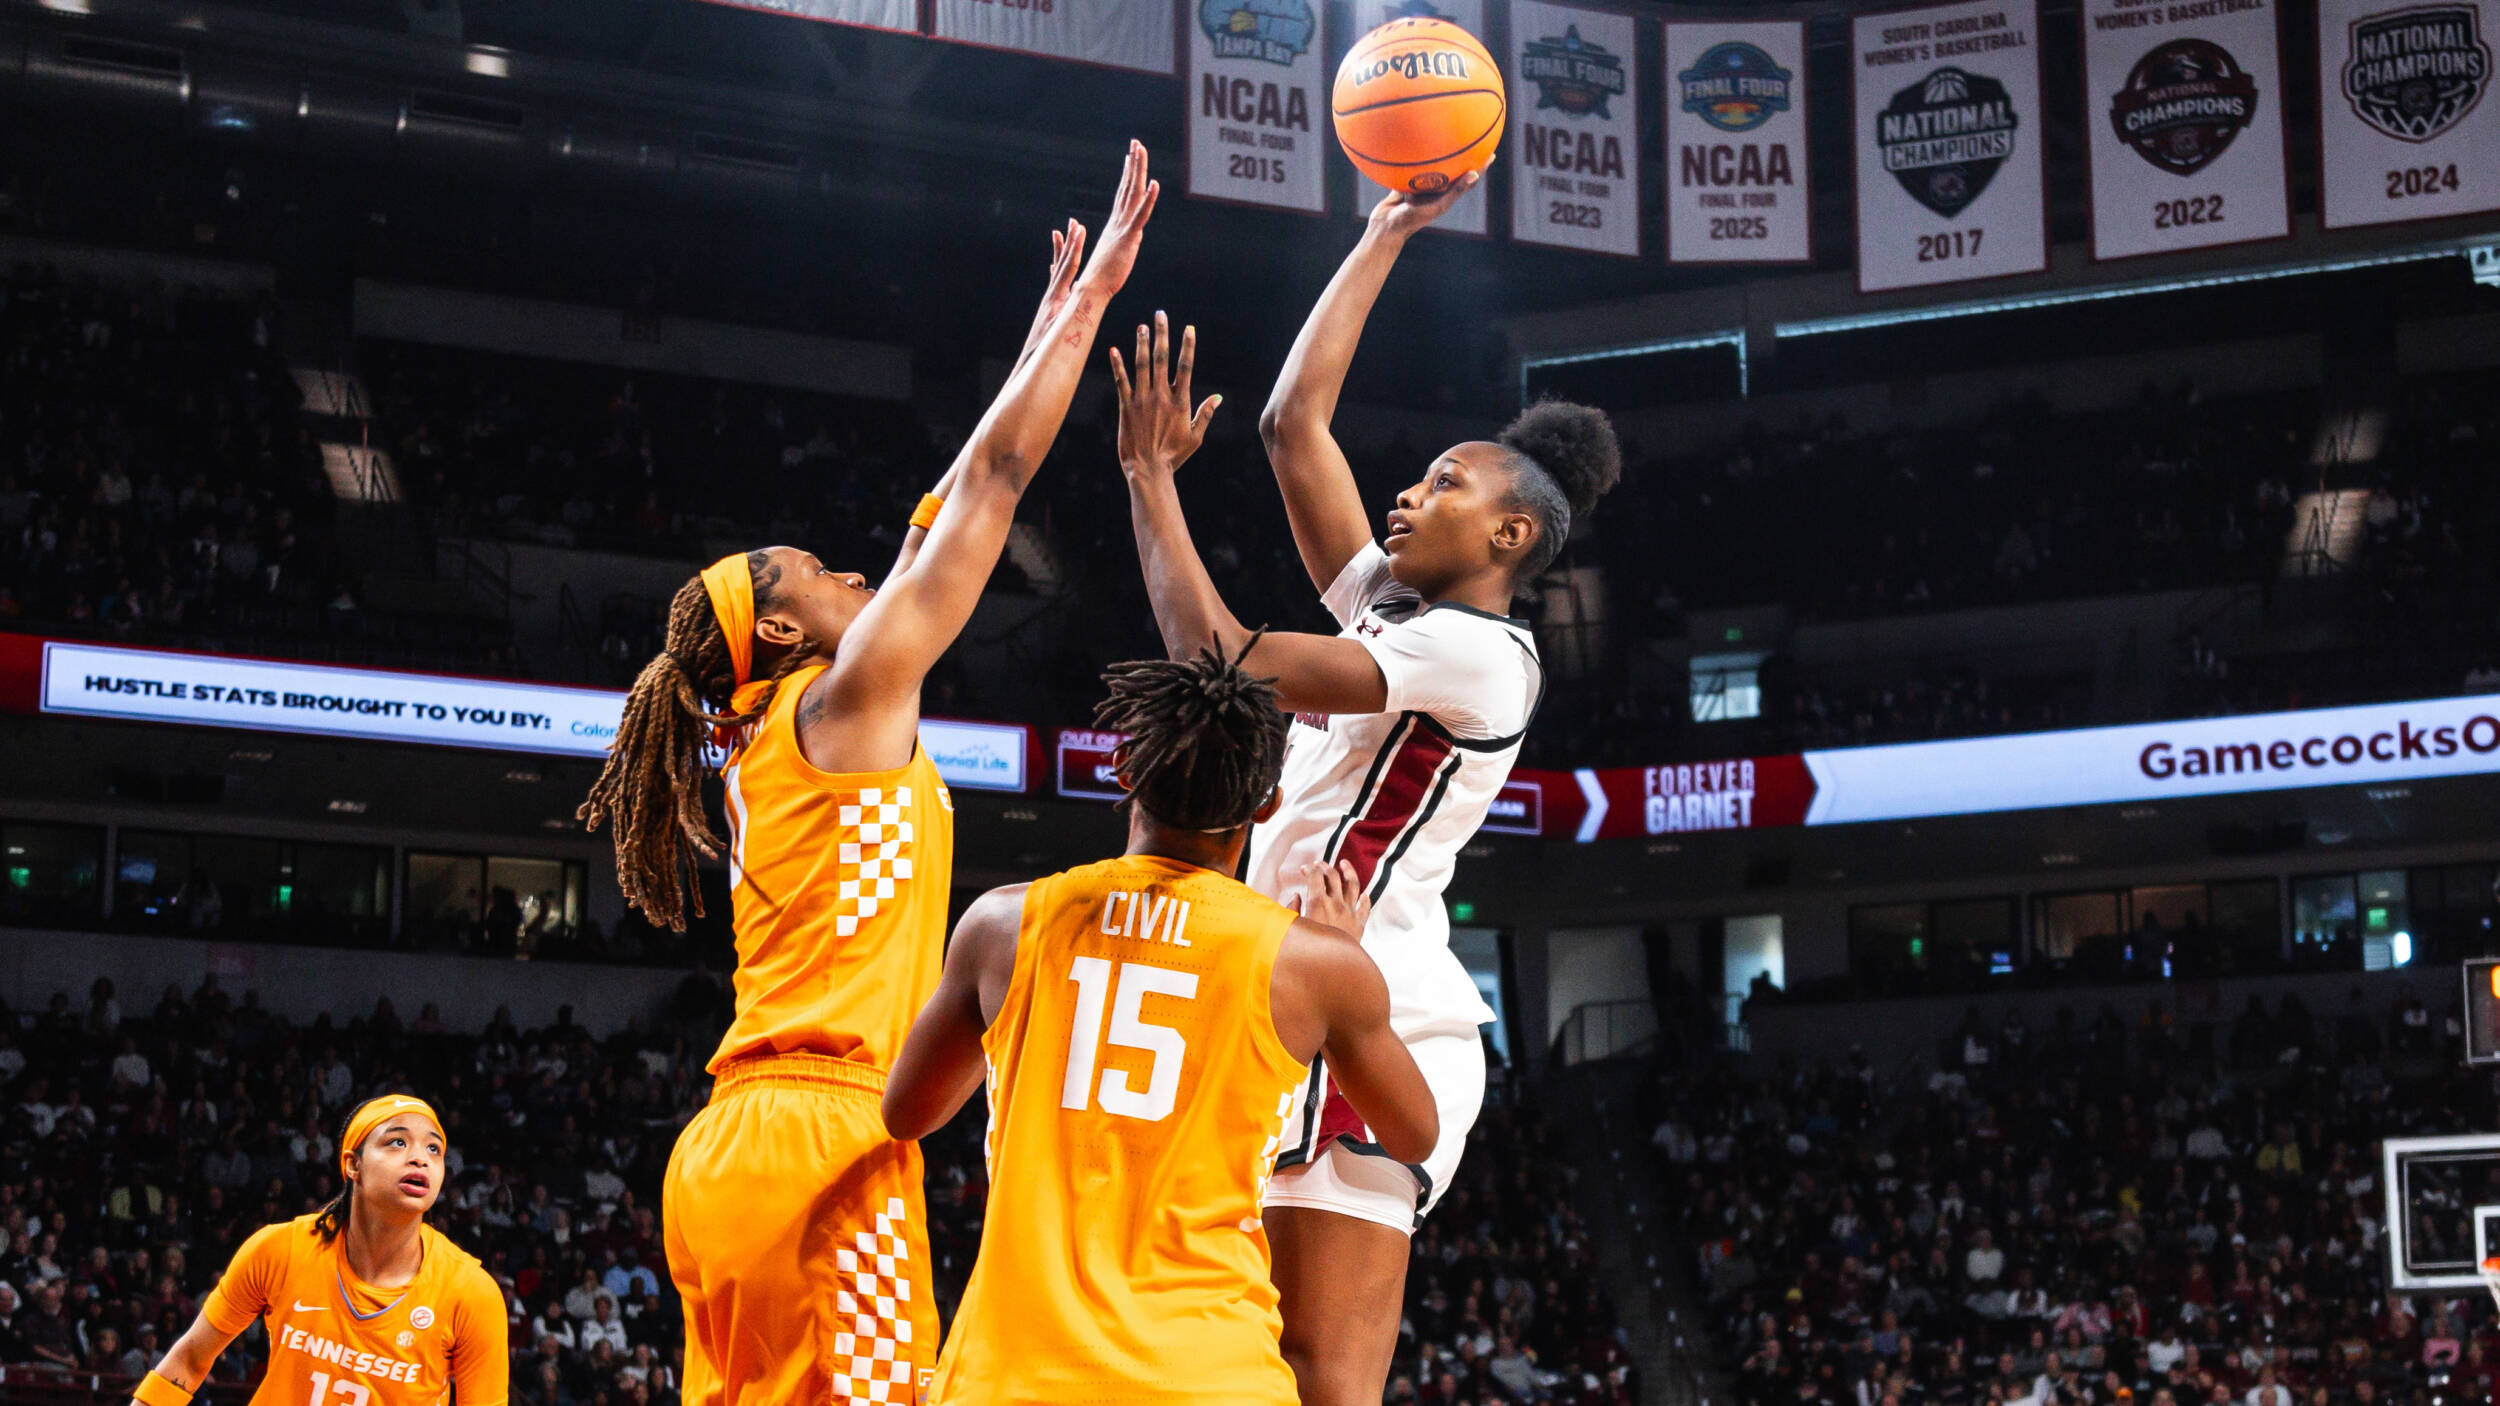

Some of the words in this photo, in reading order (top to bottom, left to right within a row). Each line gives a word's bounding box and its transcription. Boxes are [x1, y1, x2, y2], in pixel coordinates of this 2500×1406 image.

[1882, 24, 1931, 45] SOUTH
[1934, 12, 2007, 37] CAROLINA
[2361, 23, 2468, 60] NATIONAL
[1864, 45, 1930, 67] WOMEN'S
[1935, 31, 2026, 58] BASKETBALL
[1354, 52, 1468, 86] Wilson
[1525, 56, 1569, 80] FINAL
[2353, 52, 2480, 92] CHAMPIONS
[1203, 73, 1309, 132] NCAA
[1685, 77, 1733, 98] FINAL
[1739, 76, 1784, 97] FOUR
[1883, 101, 2012, 142] NATIONAL
[2125, 97, 2245, 131] CHAMPIONS
[1219, 127, 1257, 147] FINAL
[1260, 133, 1295, 152] FOUR
[1524, 123, 1625, 180] NCAA
[1891, 133, 2007, 168] CHAMPIONS
[1229, 154, 1285, 183] 2015
[1681, 143, 1794, 187] NCAA
[2386, 163, 2460, 199] 2024
[1540, 175, 1574, 194] FINAL
[1700, 194, 1737, 208] FINAL
[1741, 193, 1776, 208] FOUR
[1550, 202, 1602, 229] 2023
[1710, 217, 1768, 240] 2025
[2154, 194, 2225, 229] 2022
[1917, 228, 1984, 262] 2017
[85, 675, 187, 699] HUSTLE
[192, 684, 278, 707] STATS
[282, 692, 406, 717] BROUGHT
[412, 703, 447, 721] TO
[453, 706, 505, 725] YOU
[511, 712, 551, 730] BY:
[2139, 715, 2500, 780] GamecocksO
[1645, 760, 1755, 796] FOREVER
[1645, 790, 1754, 834] GARNET
[1100, 891, 1191, 947] CIVIL
[1061, 956, 1199, 1122] 15
[280, 1324, 422, 1383] TENNESSEE
